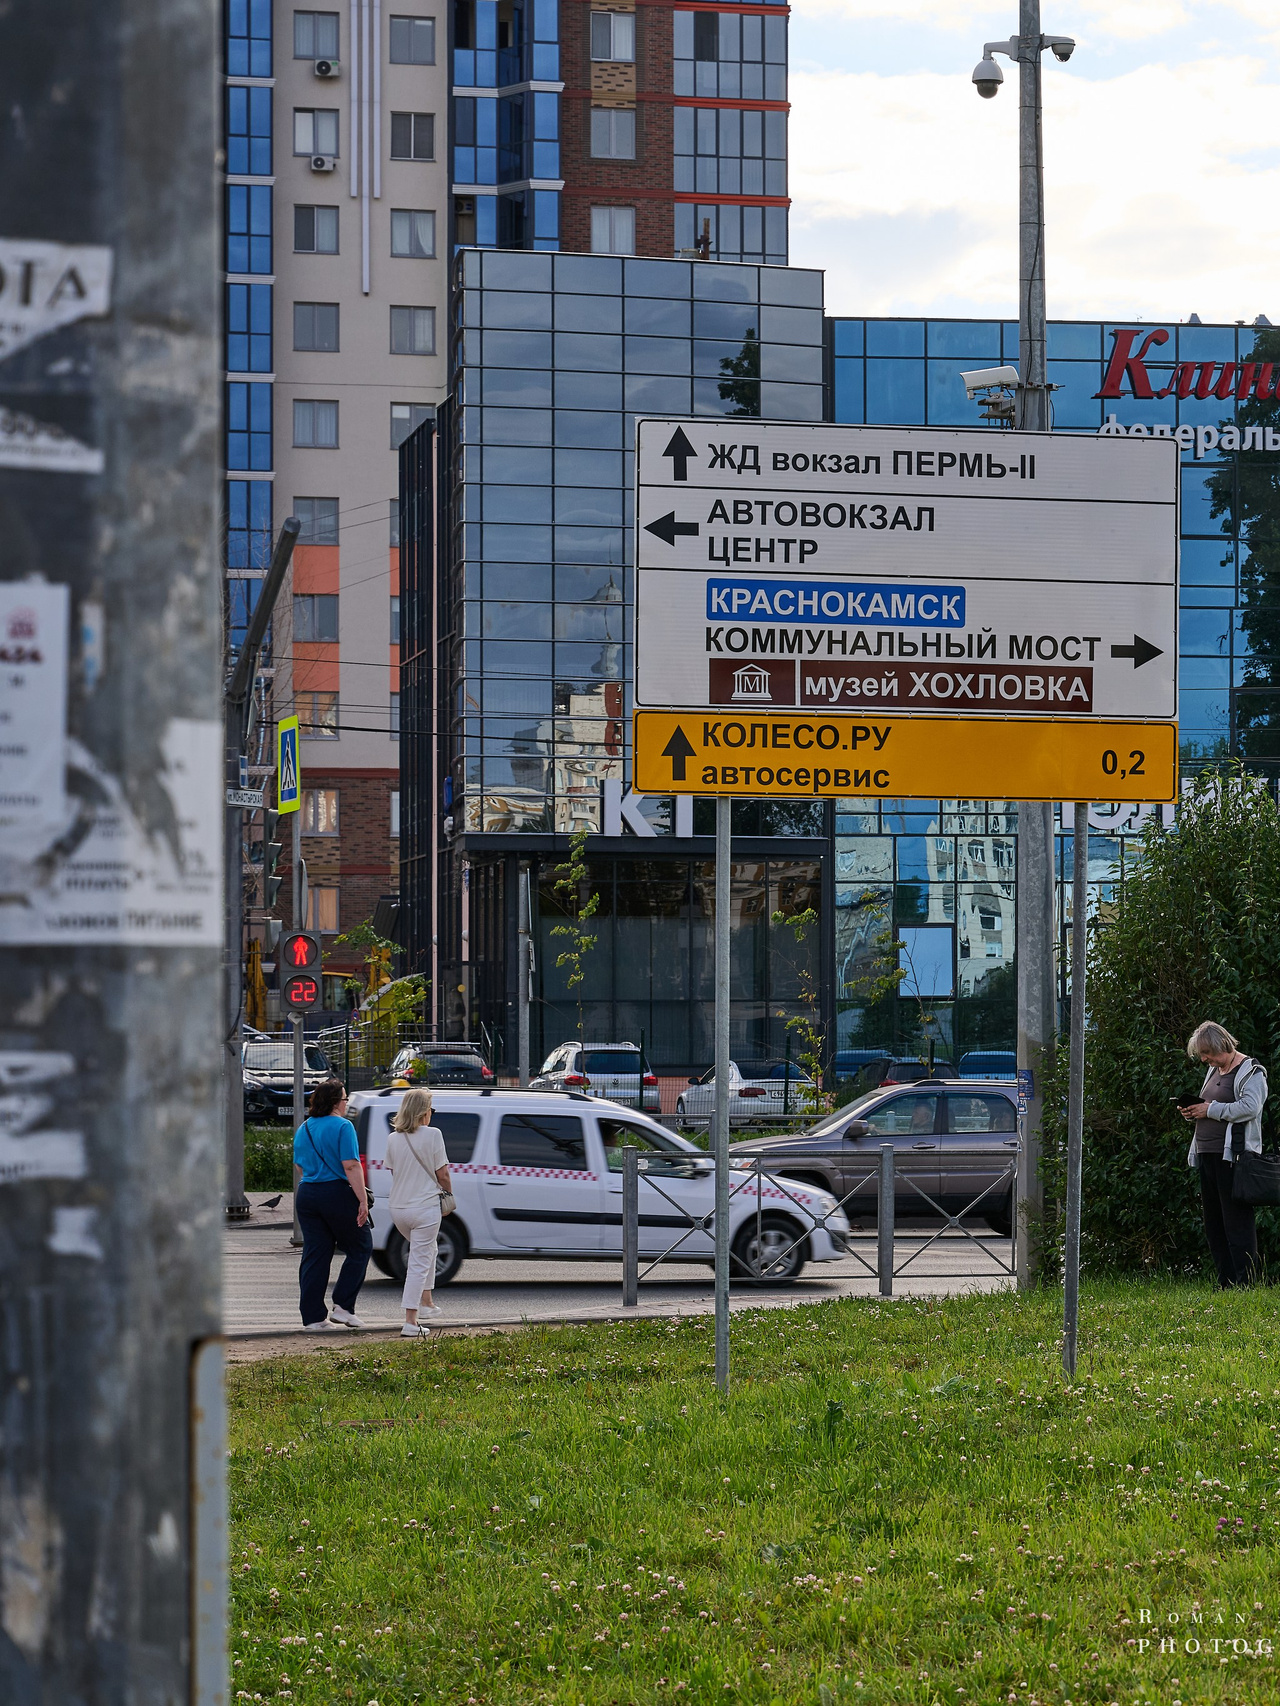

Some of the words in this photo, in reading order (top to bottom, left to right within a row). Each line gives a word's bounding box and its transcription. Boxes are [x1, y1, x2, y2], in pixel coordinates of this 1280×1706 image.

[0, 258, 88, 308] ТА
[707, 442, 761, 475] ЖД
[772, 451, 881, 475] вокзал
[892, 451, 1036, 480] ПЕРМЬ-II
[707, 500, 935, 531] АВТОВОКЗАЛ
[708, 536, 819, 567] ЦЕНТР
[710, 587, 961, 621] КРАСНОКАМСК
[706, 626, 997, 660] КОММУНАЛЬНЫЙ
[1009, 635, 1101, 662] МОСТ
[805, 670, 899, 702] музей
[908, 671, 1090, 702] ХОХЛОВКА
[702, 722, 892, 752] КОЛЕСО.РУ
[702, 764, 890, 793] автосервис
[1102, 750, 1146, 780] 0,2
[291, 982, 316, 1002] 22
